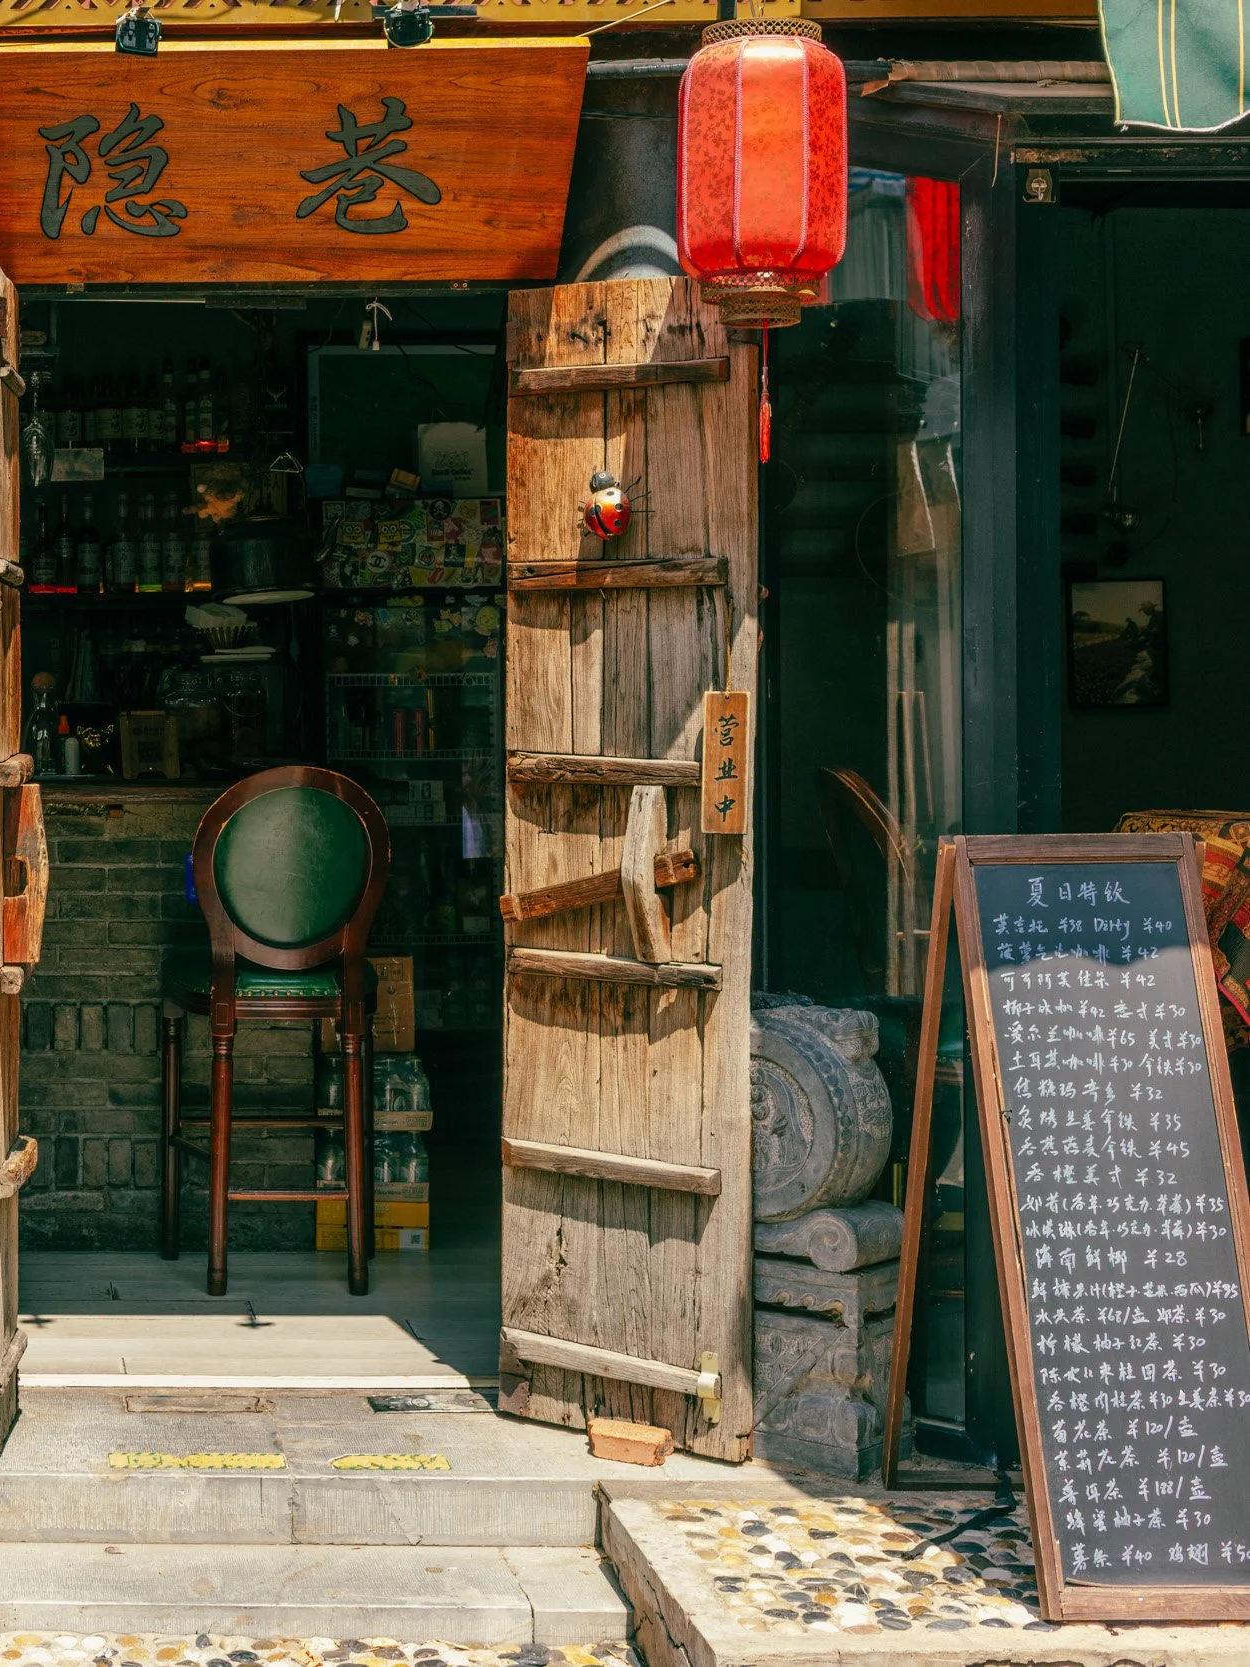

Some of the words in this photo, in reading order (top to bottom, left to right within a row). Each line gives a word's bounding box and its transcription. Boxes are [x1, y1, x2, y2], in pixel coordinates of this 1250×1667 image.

[714, 714, 739, 823] 营业中
[1027, 877, 1130, 907] 夏日特饮
[1094, 918, 1130, 941] Dirty
[1008, 1049, 1105, 1076] 土耳其咖啡
[1024, 1162, 1122, 1189] 香橙美式
[1035, 1243, 1127, 1275] 海南鲜椰
[1052, 1419, 1112, 1443] 菊花茶
[1054, 1445, 1140, 1475] 茉莉花茶
[1066, 1506, 1166, 1536] 蜂蜜柚子茶
[1071, 1542, 1112, 1575] 薯条
[1168, 1542, 1210, 1566] 鸡翅
